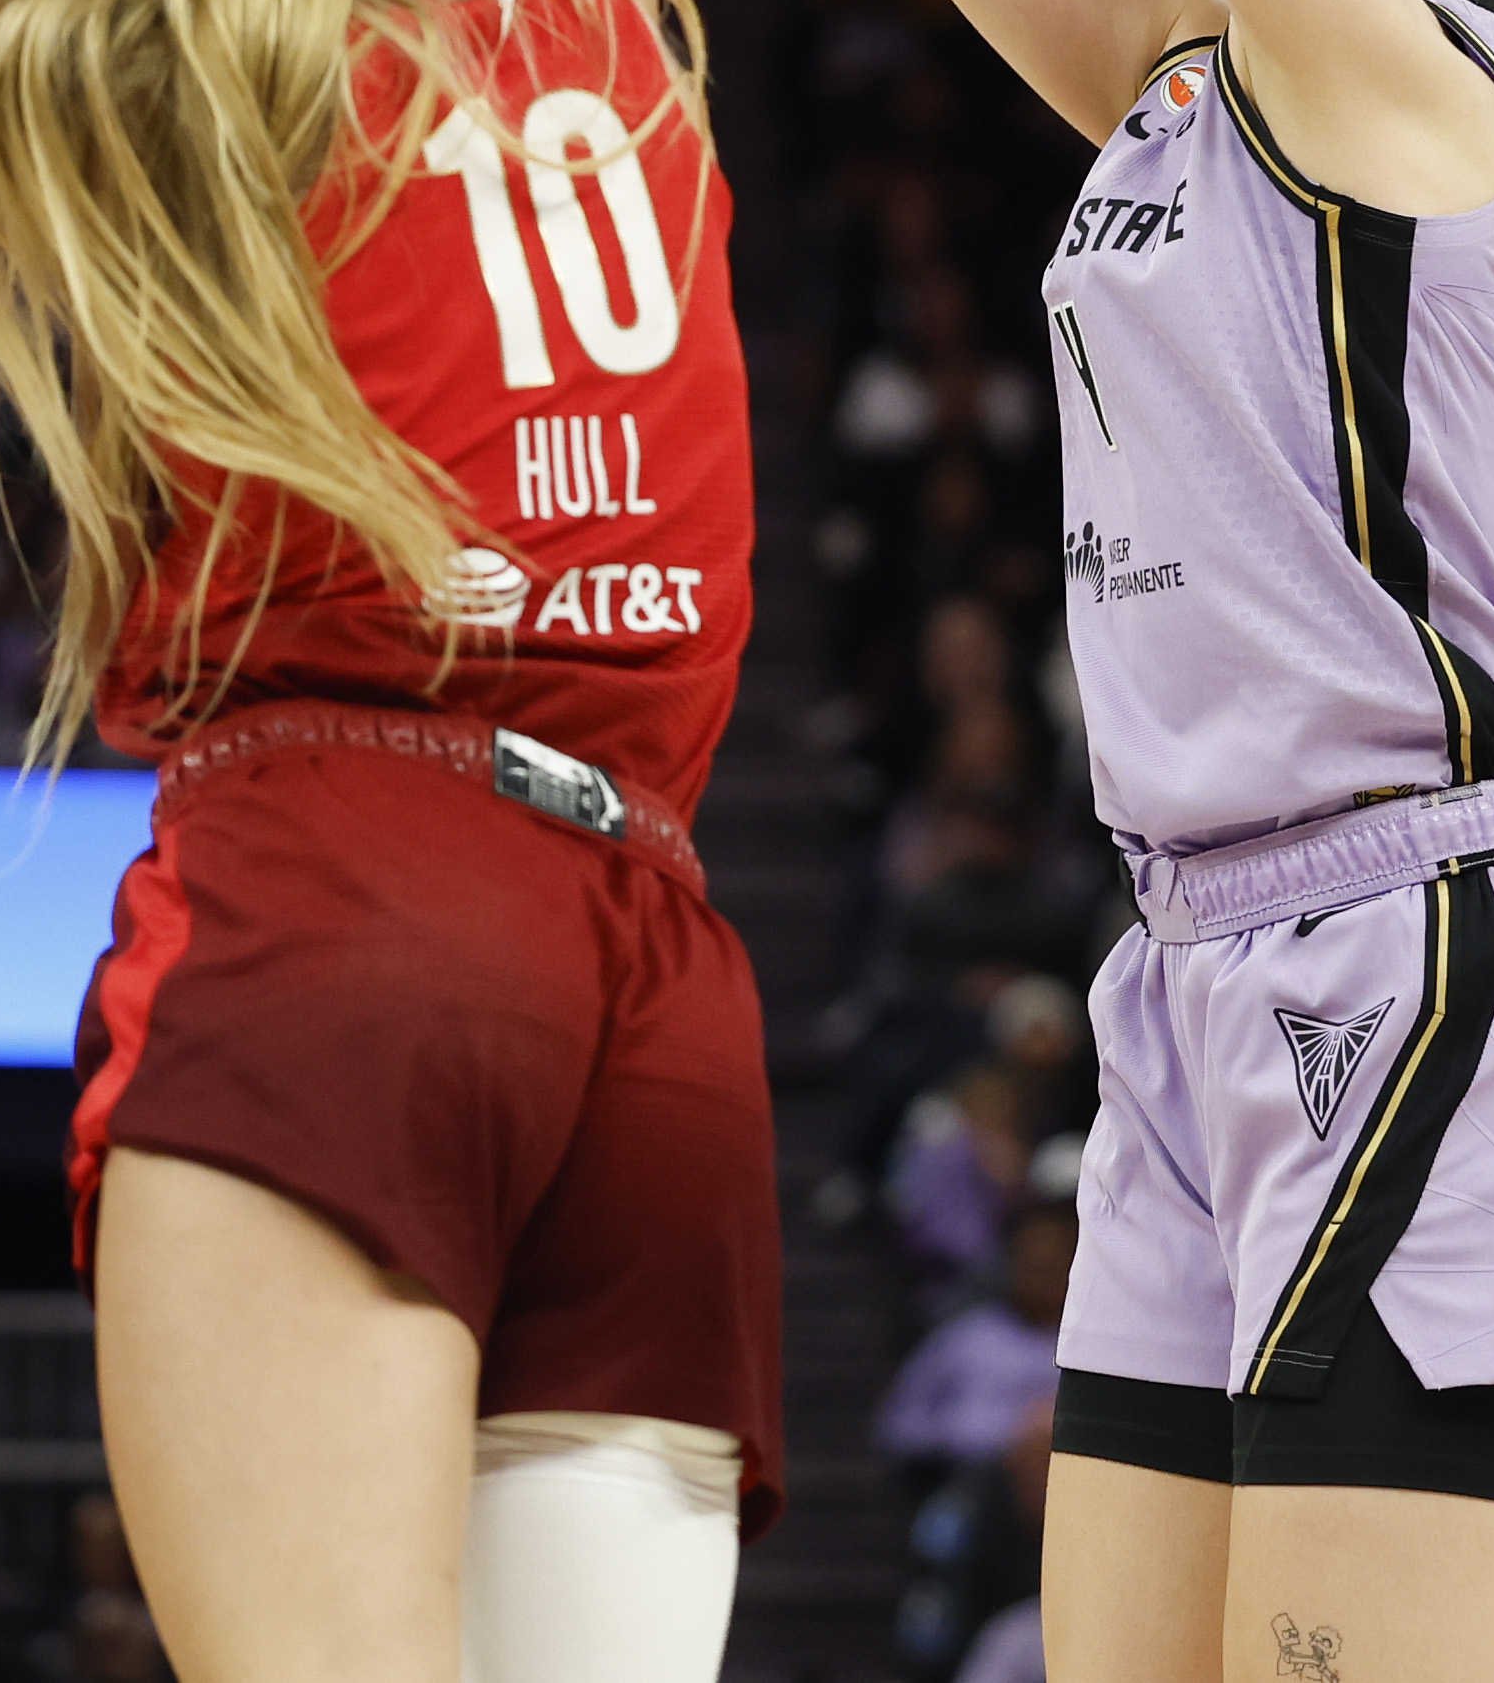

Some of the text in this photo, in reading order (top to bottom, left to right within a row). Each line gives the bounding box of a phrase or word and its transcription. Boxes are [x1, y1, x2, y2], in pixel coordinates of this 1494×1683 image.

[422, 88, 681, 389] 10
[1065, 178, 1188, 257] STAE
[515, 413, 657, 520] HULL
[534, 562, 703, 636] AT&T
